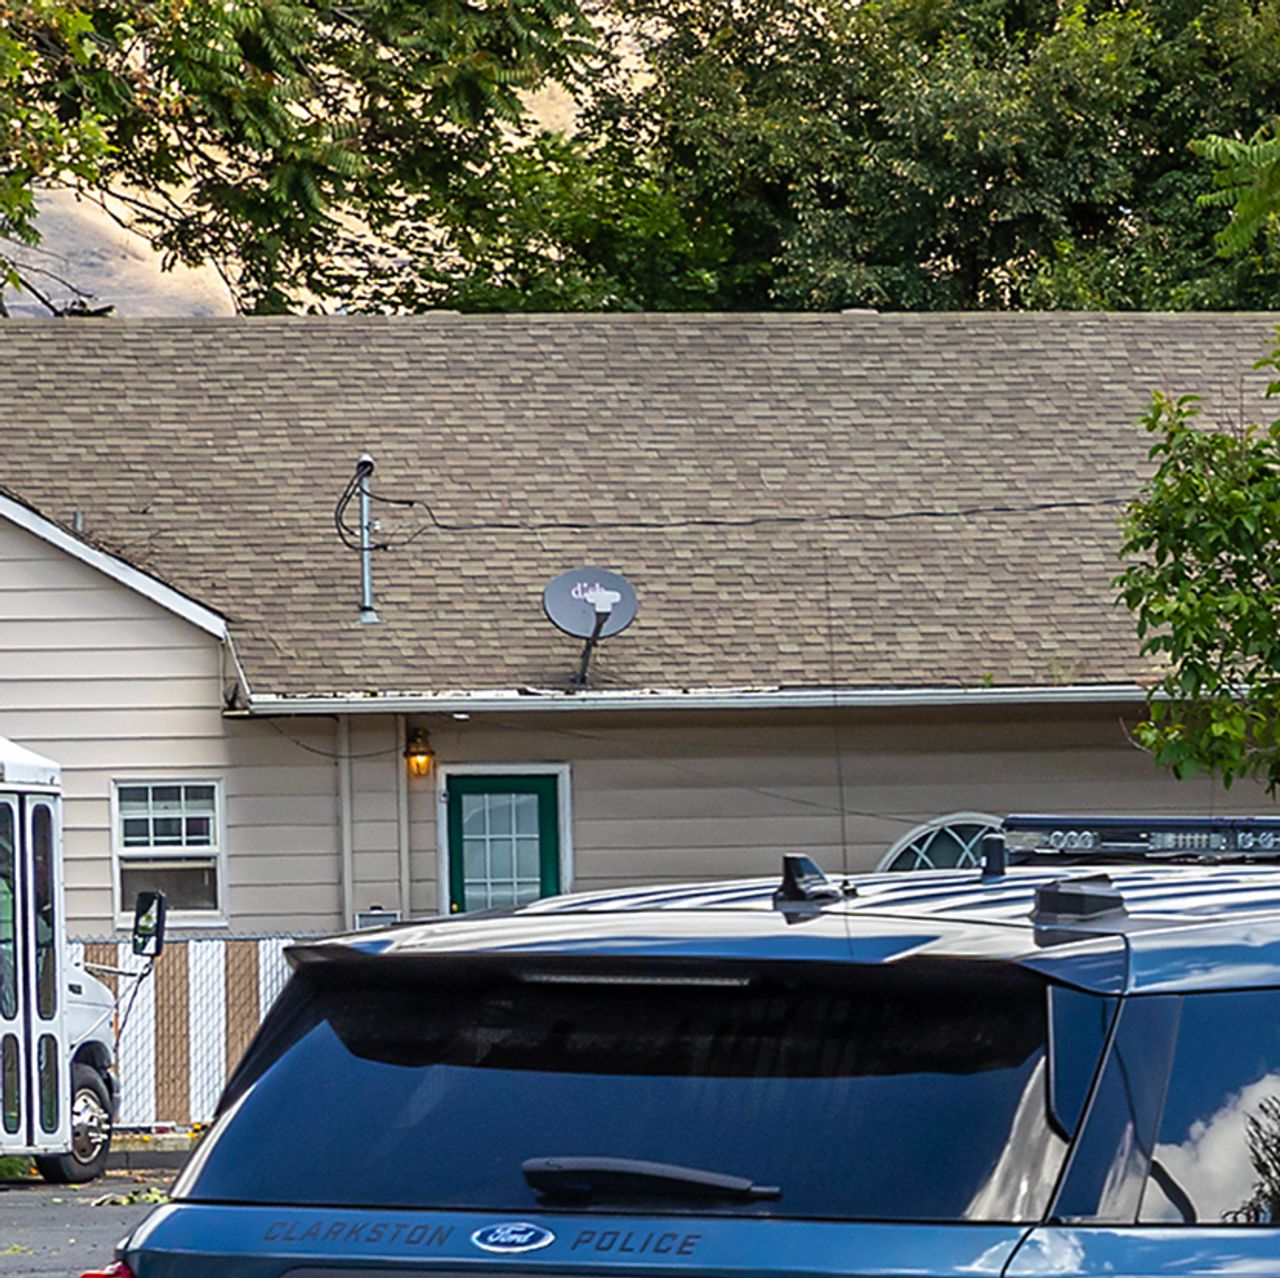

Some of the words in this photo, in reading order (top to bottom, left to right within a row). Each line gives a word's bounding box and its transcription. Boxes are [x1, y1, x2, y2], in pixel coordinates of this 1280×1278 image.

[263, 1220, 455, 1248] CLARKSTON
[486, 1225, 536, 1247] Ford
[571, 1229, 702, 1256] POLICE
